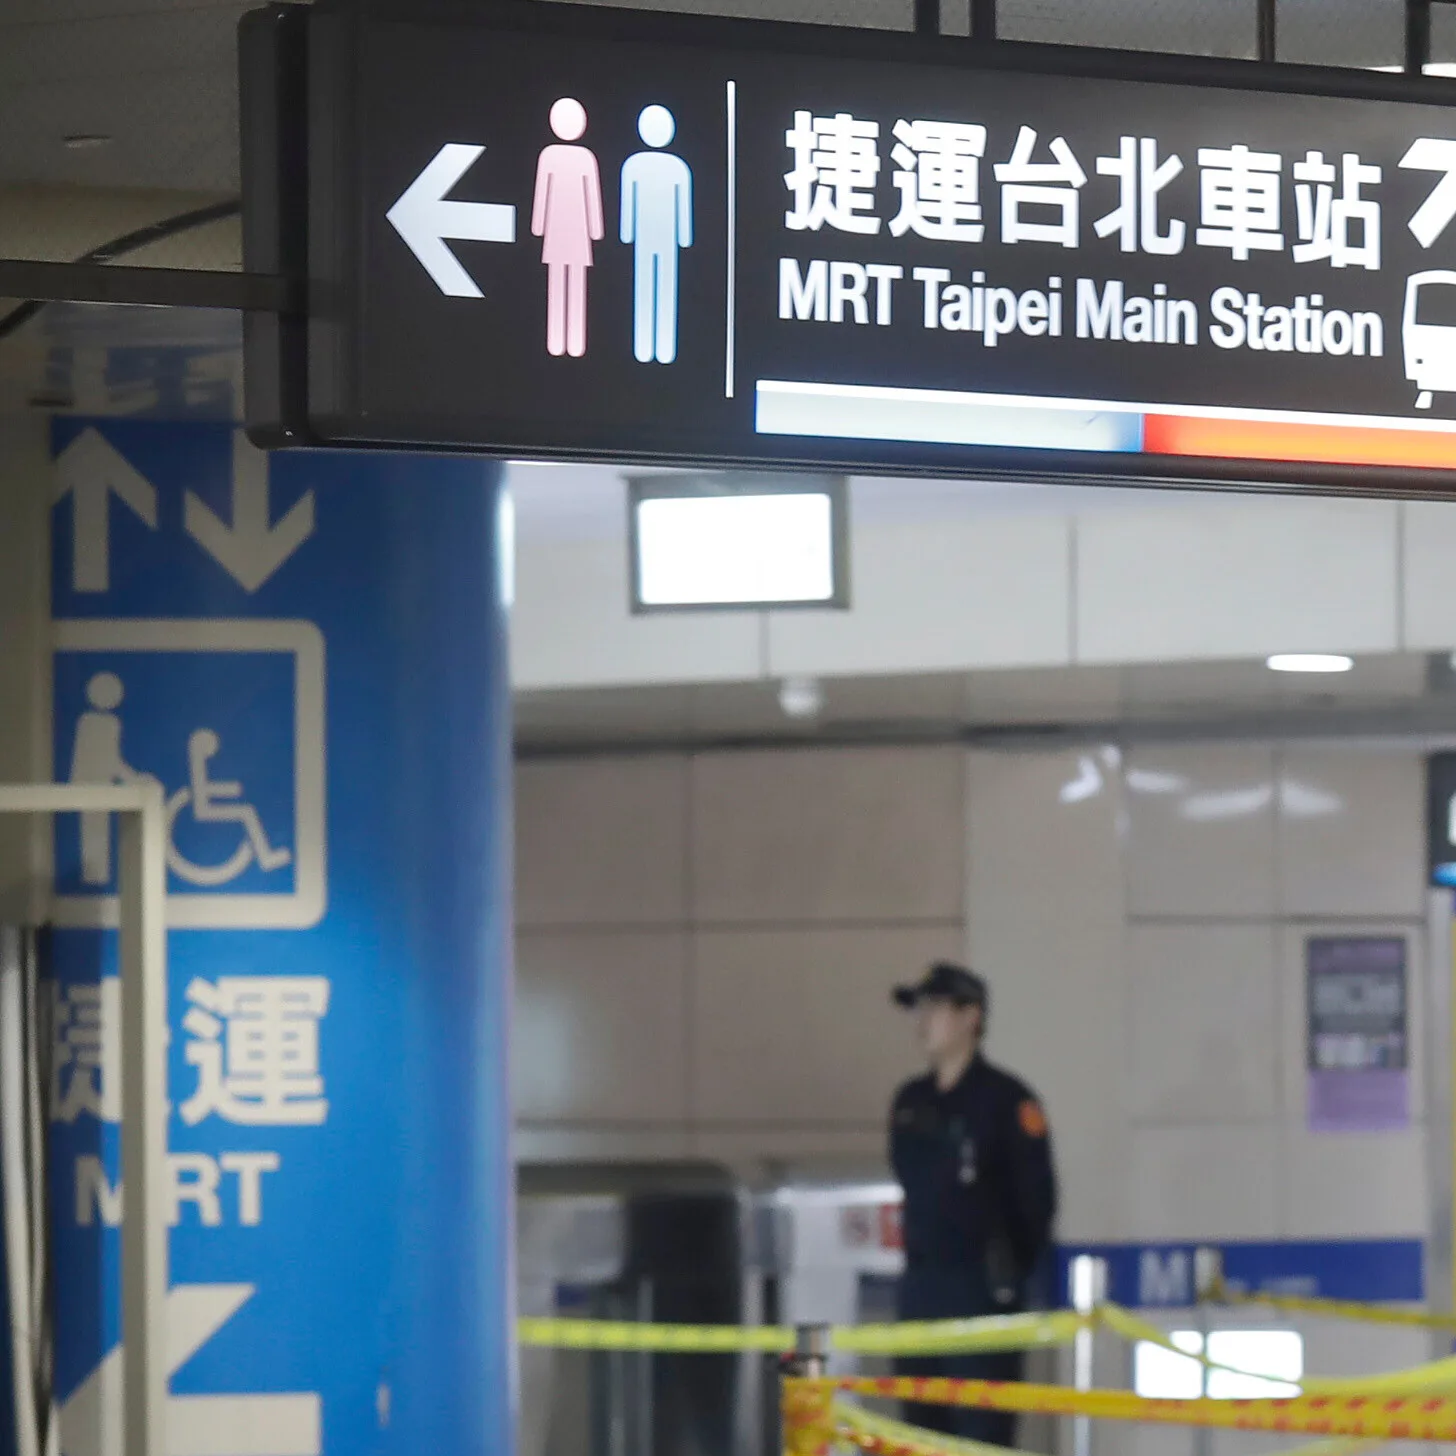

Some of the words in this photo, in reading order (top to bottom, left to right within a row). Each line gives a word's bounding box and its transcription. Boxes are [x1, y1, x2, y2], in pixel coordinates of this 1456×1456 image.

[780, 110, 1383, 270] 捷運台北車站
[778, 258, 902, 325] MRT
[913, 267, 1062, 347] Taipei
[1077, 278, 1197, 345] Main
[1209, 287, 1383, 357] Station
